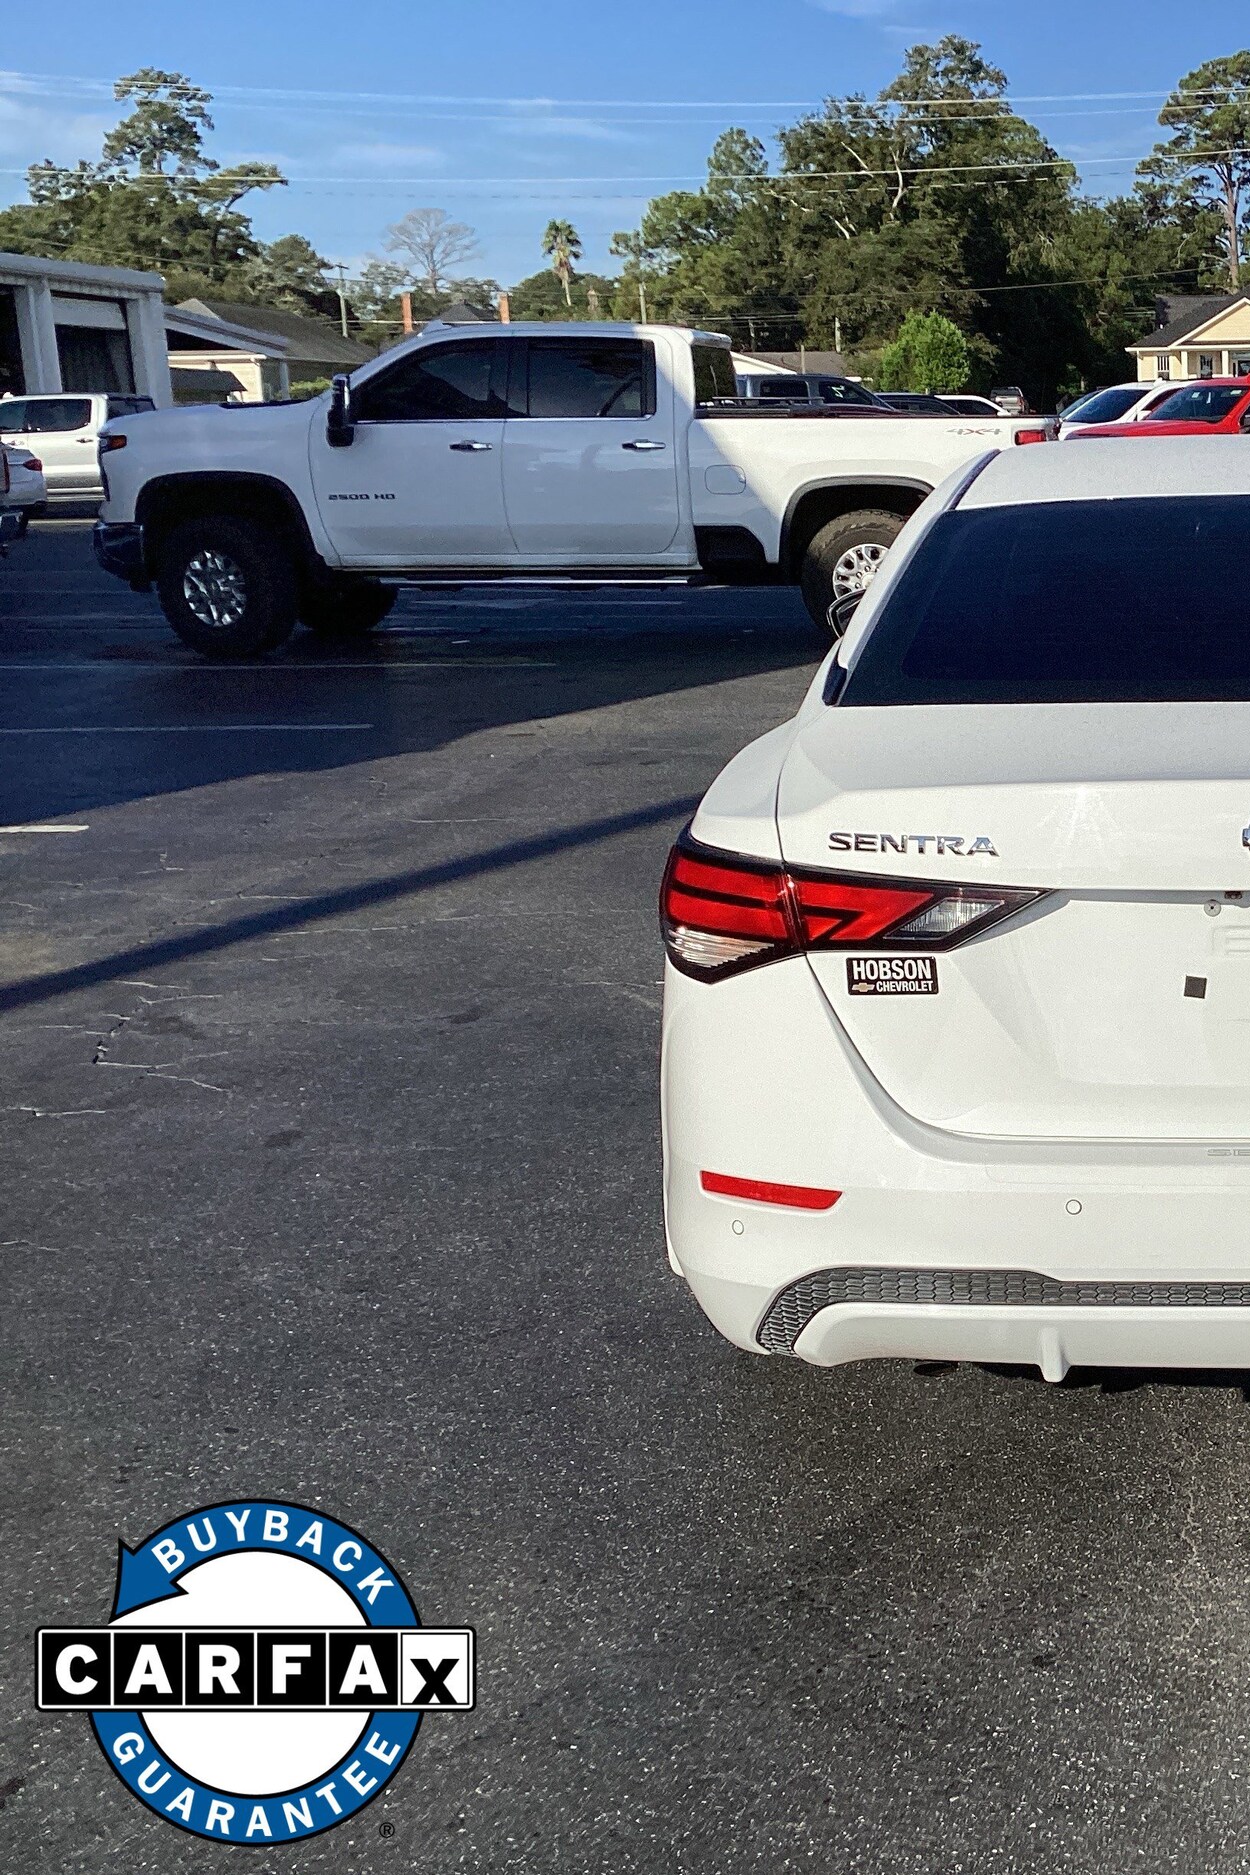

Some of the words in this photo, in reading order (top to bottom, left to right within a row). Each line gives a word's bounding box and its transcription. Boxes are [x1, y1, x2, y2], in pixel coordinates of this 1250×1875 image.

[828, 832, 1000, 857] SENTRA
[852, 959, 932, 980] HOBSON
[876, 980, 934, 992] CHEVROLET
